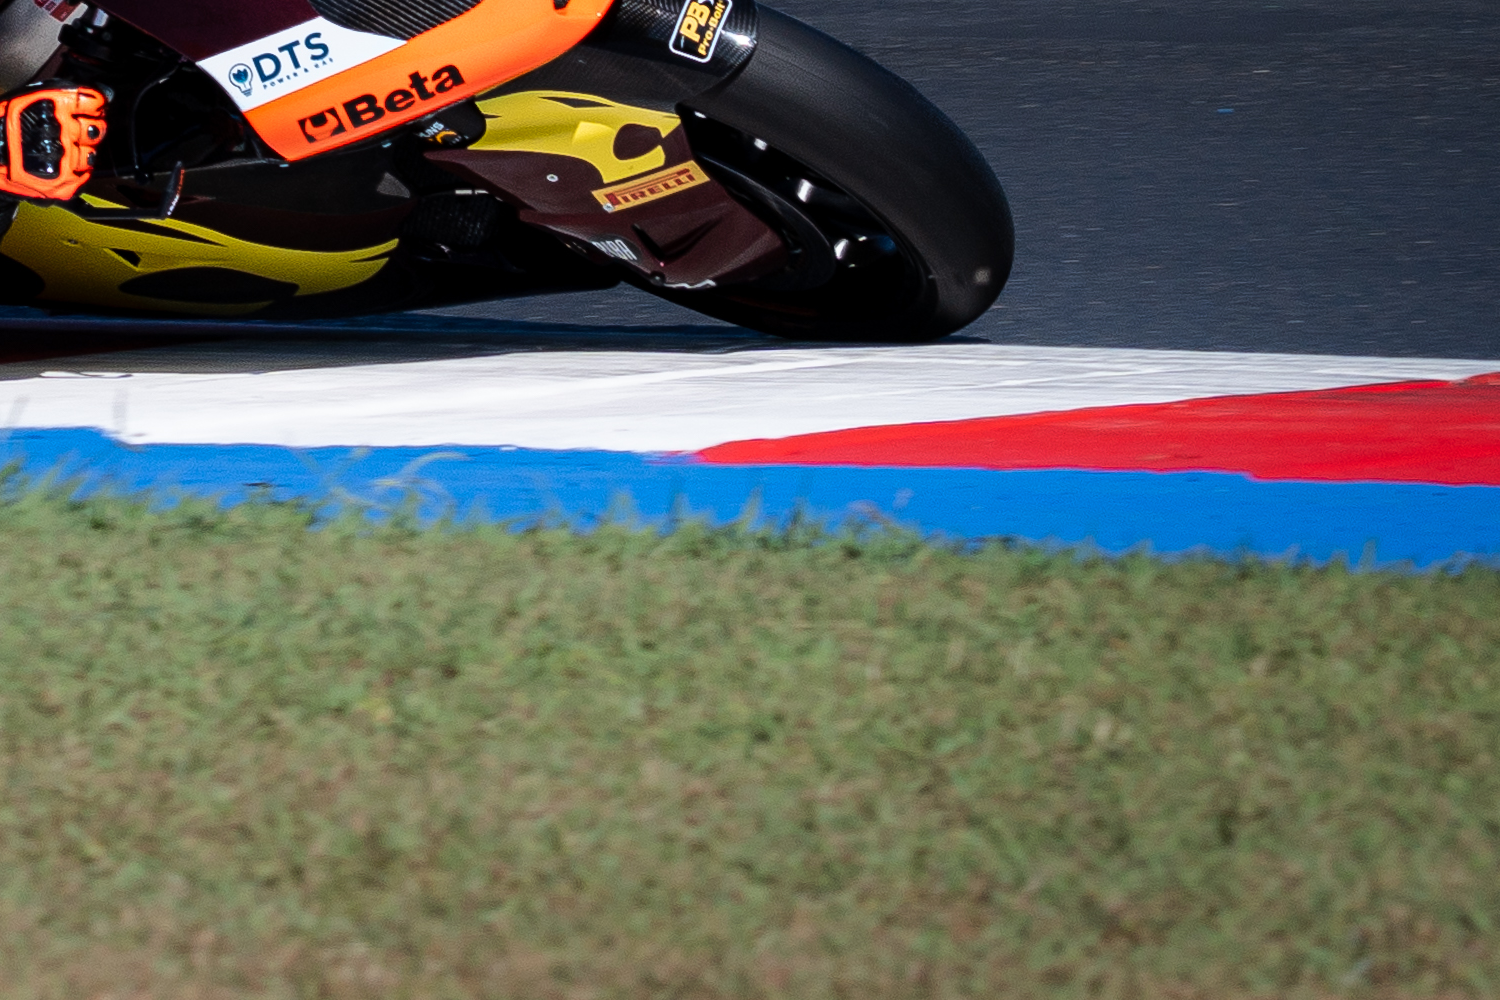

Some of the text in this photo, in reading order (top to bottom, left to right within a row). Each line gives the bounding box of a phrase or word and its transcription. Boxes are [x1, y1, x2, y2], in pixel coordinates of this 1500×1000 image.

[679, 1, 711, 43] PB
[252, 32, 330, 83] DTS
[343, 64, 466, 129] Beta
[603, 168, 696, 207] PIRELLI
